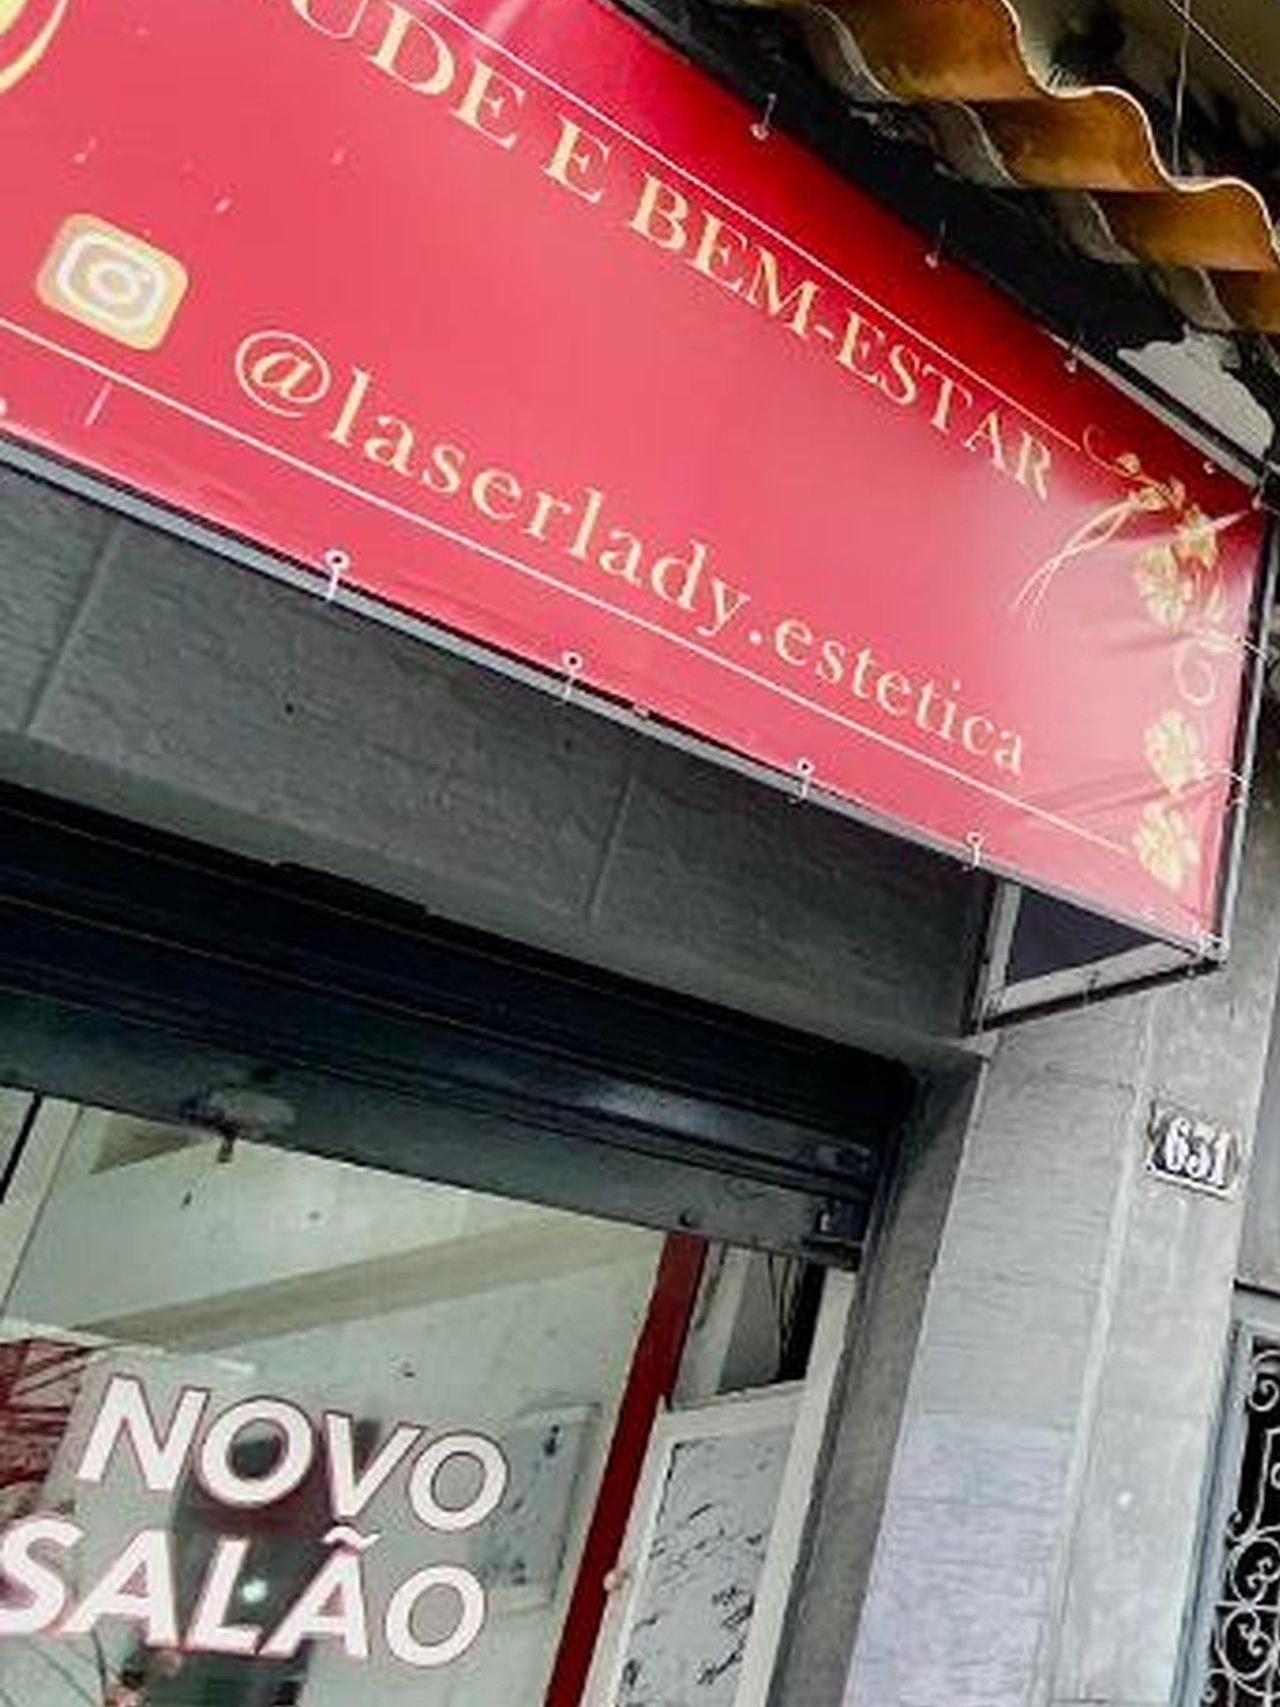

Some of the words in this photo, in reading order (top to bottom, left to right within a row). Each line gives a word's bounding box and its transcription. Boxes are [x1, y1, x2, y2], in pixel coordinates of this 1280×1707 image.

[541, 114, 610, 205] E
[627, 168, 1054, 503] BEM-ESTAR
[233, 328, 1029, 779] @laserlady.estetica
[74, 1374, 509, 1533] NOVO
[0, 1514, 487, 1669] SALÃO
